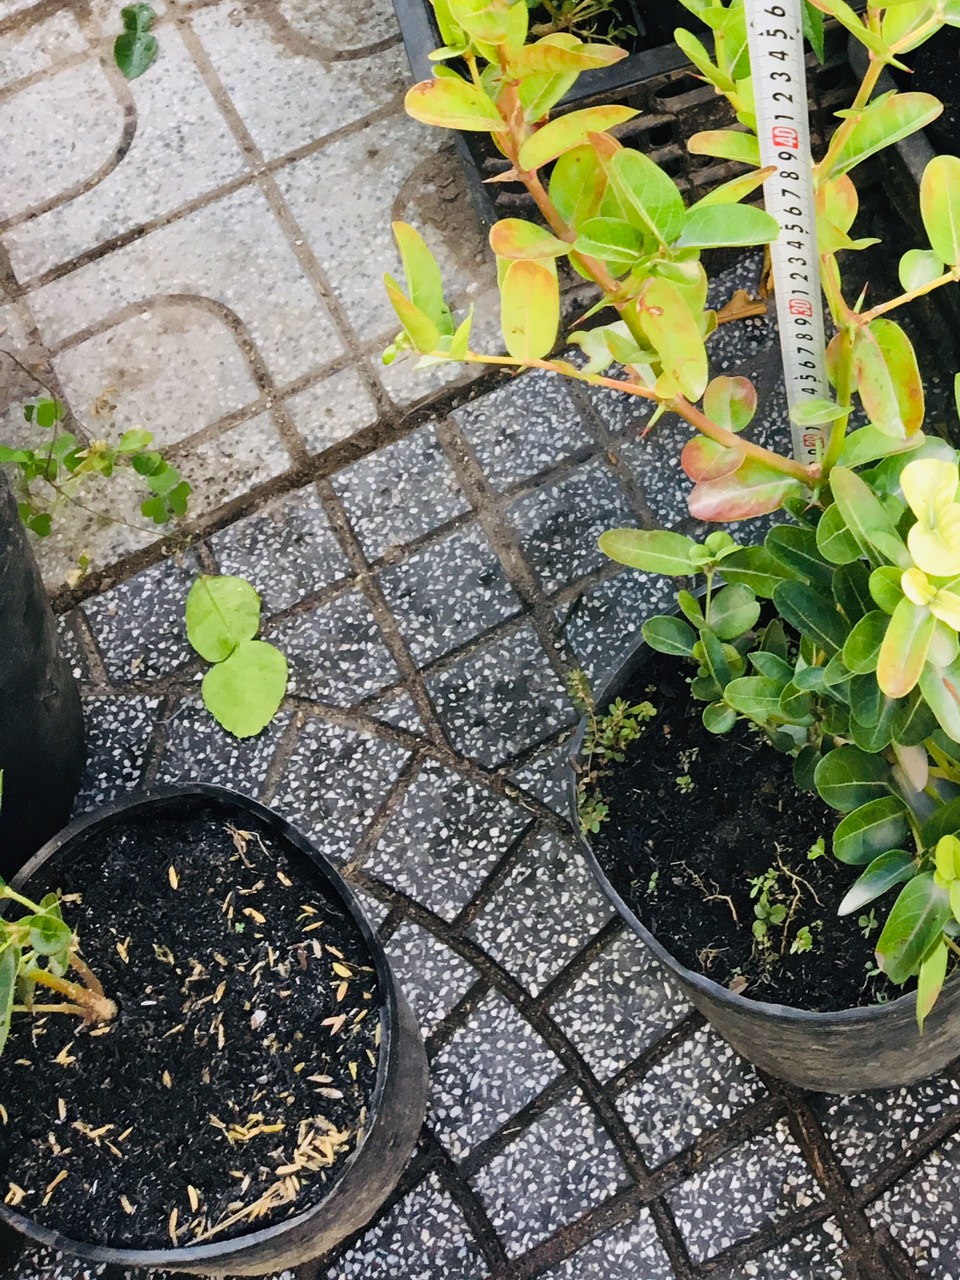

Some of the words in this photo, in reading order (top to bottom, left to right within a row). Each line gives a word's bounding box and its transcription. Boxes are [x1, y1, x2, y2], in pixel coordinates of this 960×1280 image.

[764, 5, 786, 18] 6
[766, 28, 788, 40] 5
[768, 50, 789, 62] 4
[769, 71, 792, 83] 3
[772, 92, 794, 103] 2
[773, 127, 797, 147] 40
[778, 151, 798, 161] 9
[779, 170, 800, 181] 8
[781, 188, 801, 199] 7
[783, 206, 803, 217] 6
[784, 224, 804, 234] 5
[786, 240, 805, 250] 4
[787, 257, 807, 267] 3
[789, 272, 809, 283] 2
[790, 301, 811, 316] 30
[794, 317, 812, 326] 9
[795, 332, 814, 342] 8
[796, 346, 815, 356] 7
[798, 360, 816, 369] 6
[799, 374, 818, 383] 5
[801, 387, 818, 395] 4
